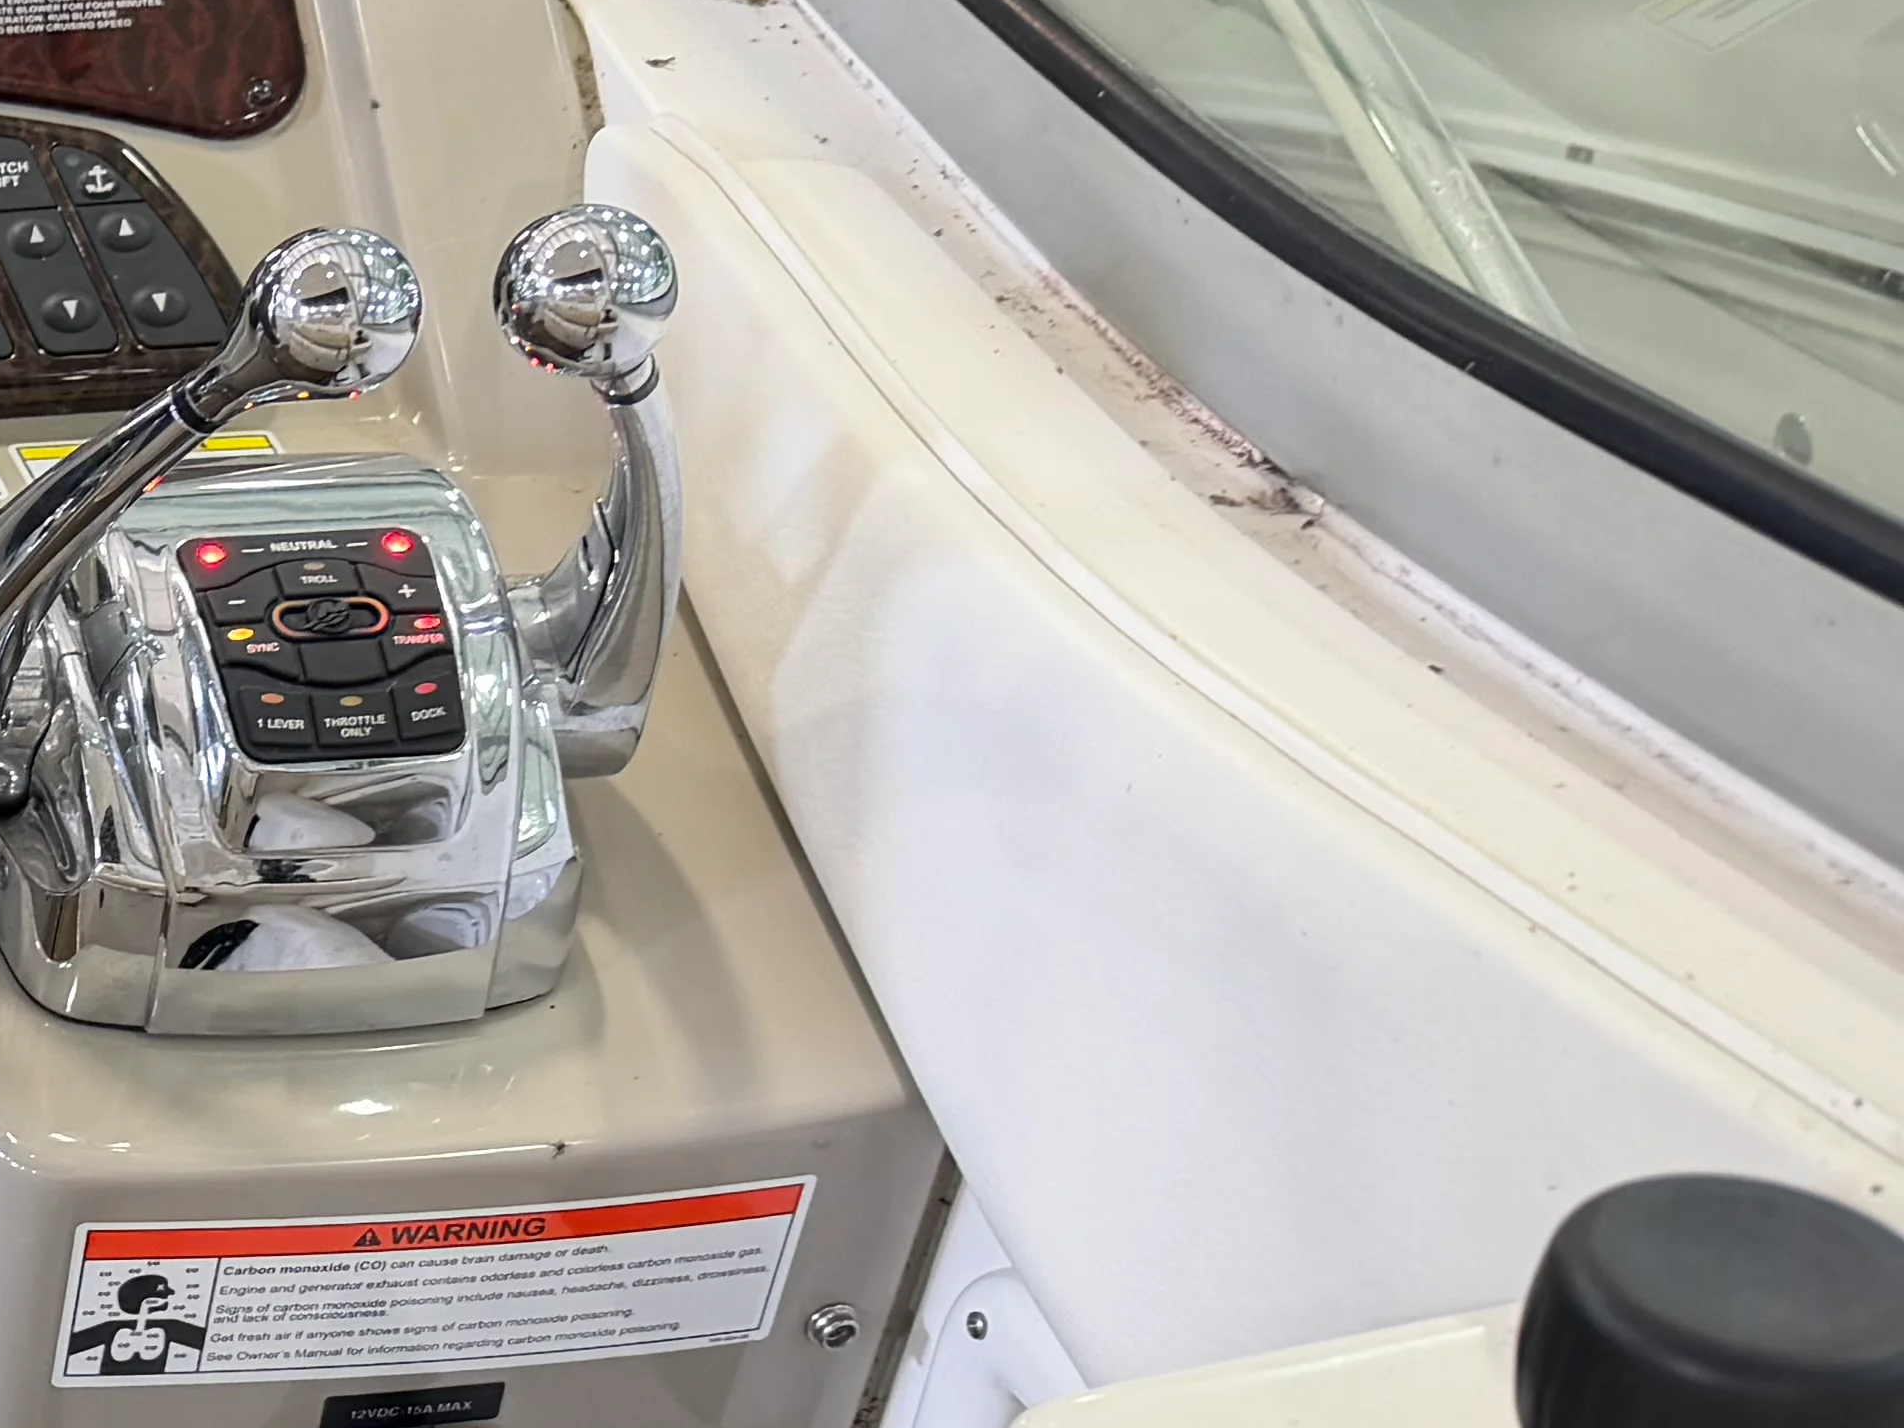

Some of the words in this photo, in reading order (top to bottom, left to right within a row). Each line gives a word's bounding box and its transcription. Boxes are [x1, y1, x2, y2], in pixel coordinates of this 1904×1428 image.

[270, 539, 338, 553] NEUTRAL
[299, 574, 338, 584] TROLL
[392, 633, 445, 646] TRANSFER
[246, 642, 280, 654] SYNC
[324, 713, 386, 729] THROTTLE
[411, 706, 445, 722] DOCK
[340, 726, 372, 739] ONLY
[392, 1218, 546, 1245] WARNING
[224, 1265, 275, 1276] Carbon
[279, 1262, 351, 1274] monoxide
[354, 1260, 386, 1272] (CO)
[390, 1260, 415, 1270] can
[418, 1258, 459, 1267] cause
[462, 1255, 494, 1265] brain
[498, 1251, 551, 1263] damage
[555, 1249, 570, 1258] or
[572, 1245, 609, 1256] death.
[219, 1285, 266, 1296] Engine
[270, 1284, 296, 1294] and
[299, 1281, 363, 1294] generator
[366, 1279, 419, 1290] exhaust
[422, 1274, 477, 1286] contains
[480, 1271, 535, 1283] odorless
[540, 1268, 564, 1277] and
[568, 1263, 624, 1276] colorless
[627, 1258, 671, 1270] carbon
[674, 1250, 735, 1264] monoxide
[738, 1247, 764, 1259] gas.
[210, 1333, 234, 1343] Get
[238, 1331, 271, 1342] fresh
[274, 1331, 291, 1340] air
[295, 1331, 304, 1340] if
[307, 1328, 355, 1340] anyone
[358, 1325, 401, 1337] shows
[404, 1324, 438, 1336] signs
[442, 1322, 456, 1332] of
[458, 1319, 502, 1331] carbon
[505, 1314, 568, 1328] monoxide
